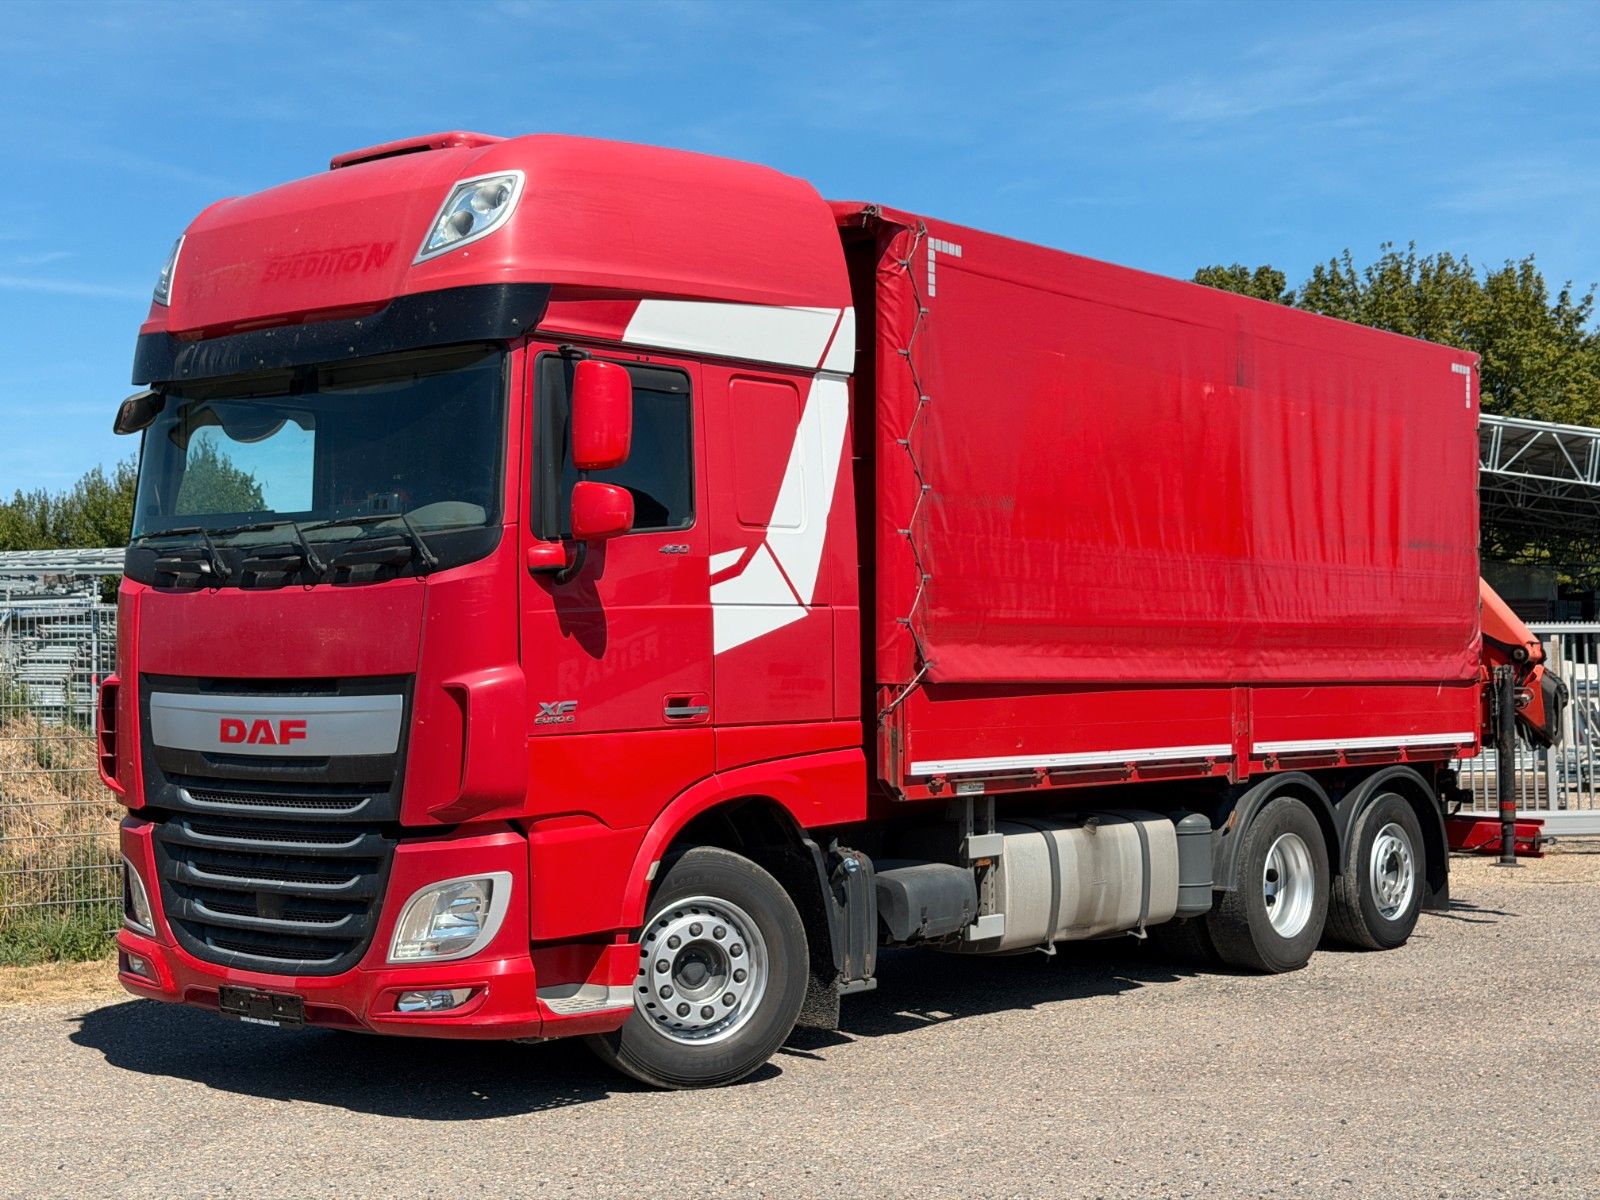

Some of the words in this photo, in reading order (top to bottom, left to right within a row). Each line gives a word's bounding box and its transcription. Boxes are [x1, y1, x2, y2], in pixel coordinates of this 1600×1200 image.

[261, 240, 397, 284] SPEDITION
[535, 699, 578, 717] XF
[219, 718, 308, 745] DAF
